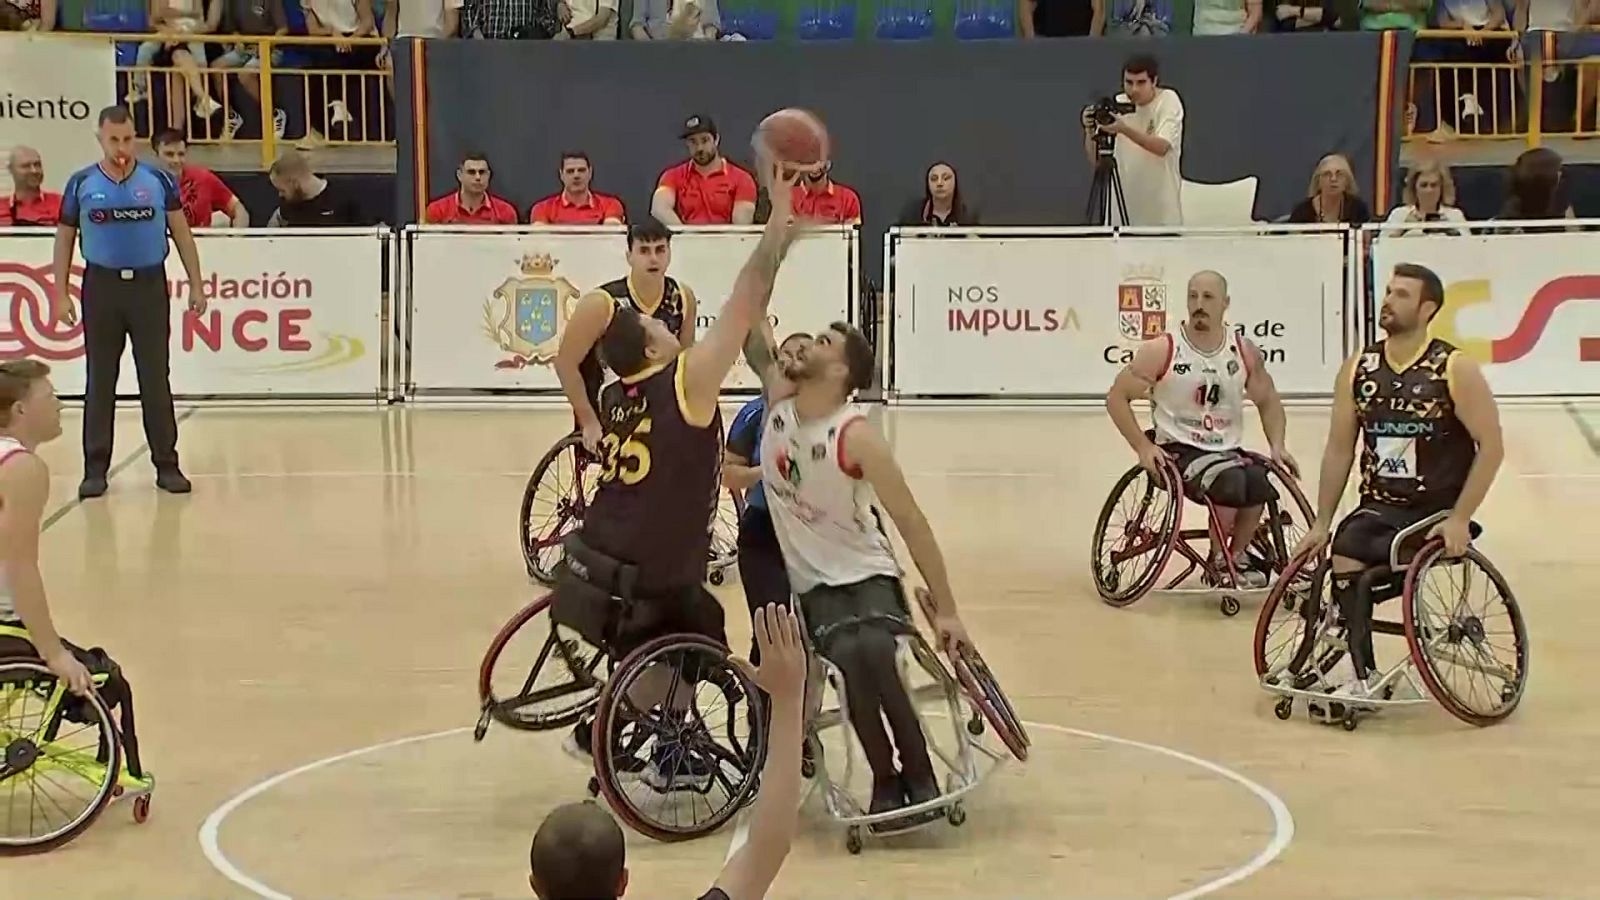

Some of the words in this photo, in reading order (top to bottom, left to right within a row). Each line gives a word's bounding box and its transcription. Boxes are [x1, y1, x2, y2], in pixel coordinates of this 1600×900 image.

[168, 271, 312, 299] ndación
[948, 286, 999, 303] NOS
[182, 308, 312, 352] NCE
[948, 307, 1080, 336] IMPULSA
[1254, 320, 1285, 337] de
[1195, 384, 1220, 406] 14
[1390, 398, 1405, 410] 12
[602, 416, 652, 485] 35
[1377, 457, 1409, 474] AXA
